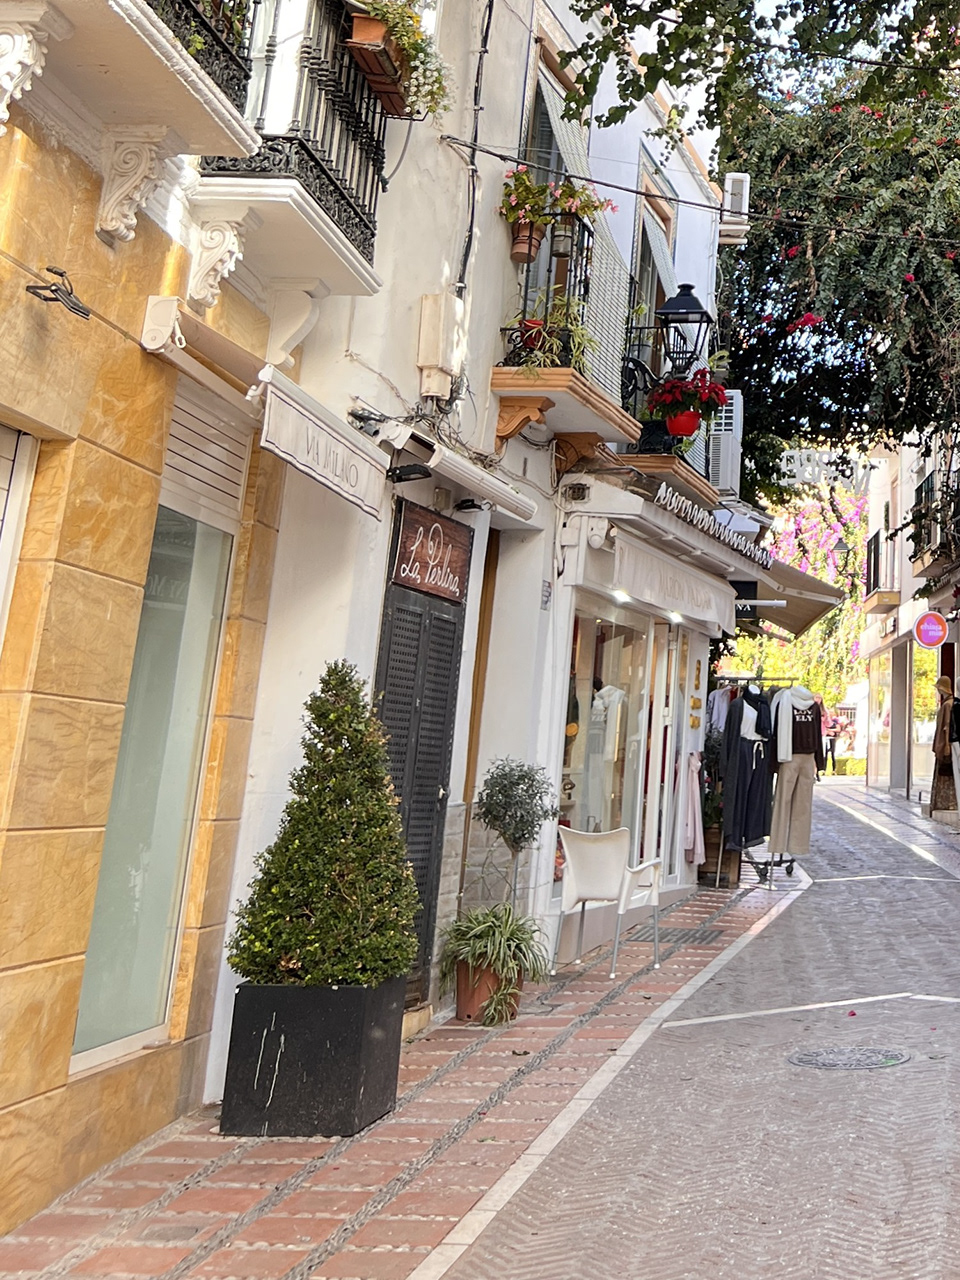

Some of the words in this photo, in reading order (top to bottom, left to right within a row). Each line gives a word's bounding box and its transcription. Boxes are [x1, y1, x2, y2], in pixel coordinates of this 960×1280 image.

[306, 426, 320, 466] VIA
[323, 443, 359, 489] MILANO
[400, 526, 424, 584] La
[424, 523, 460, 597] Perlina
